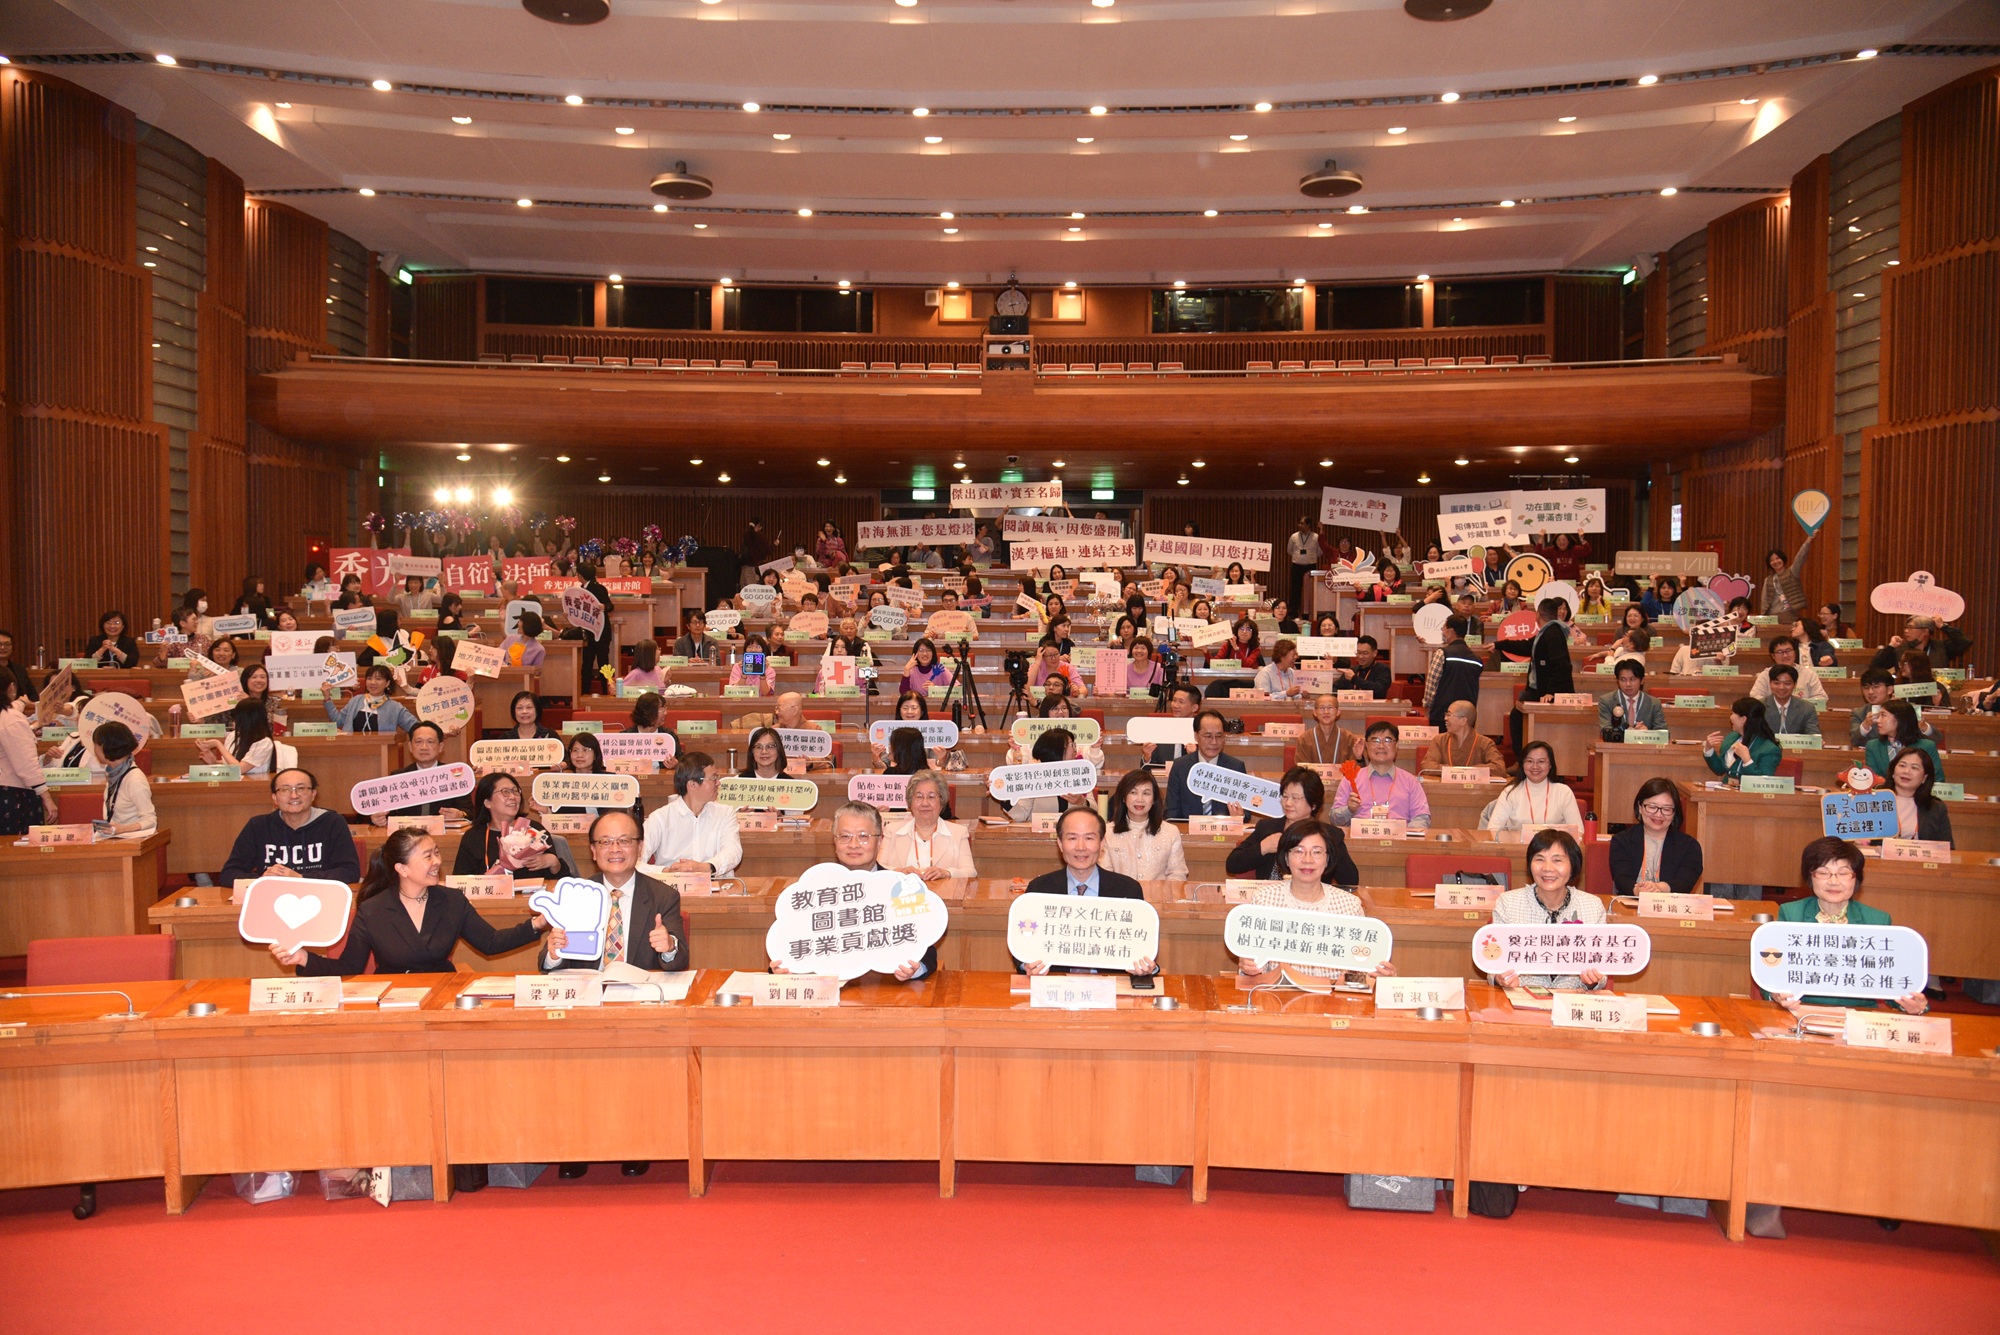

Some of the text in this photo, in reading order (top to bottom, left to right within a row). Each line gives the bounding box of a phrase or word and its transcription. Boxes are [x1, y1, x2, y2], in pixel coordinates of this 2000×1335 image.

[951, 487, 1062, 500] 傑出貢獻，實至名歸
[859, 522, 974, 539] 書海無涯，您是燈塔
[1004, 519, 1120, 538] 閱讀風氣，因您盛開
[1011, 543, 1135, 561] 漢學樞紐，連結全球
[1145, 538, 1271, 562] 卓越國圖，因您打造
[446, 561, 490, 586] 自衍
[543, 581, 641, 592] 香光尼眾院圖書館
[569, 607, 579, 618] FU
[872, 615, 904, 627] GO GO GO
[457, 651, 499, 668] 地方首長獎
[422, 693, 470, 715] 地方首長獎
[1004, 766, 1090, 782] 電影特色與創意閱讀
[358, 772, 449, 799] 讓閱讀成為吸引力的
[542, 780, 630, 791] 專業實證與人文關懷
[719, 783, 813, 795] 樂齡學習與城鄉共榮的
[1006, 777, 1092, 793] 推廣的在地文化據點
[1192, 778, 1249, 803] 智慧化圖書館
[541, 791, 610, 802] 並進的醫學樞紐
[719, 793, 775, 803] 社區生活核心
[264, 842, 323, 865] FJCU
[790, 882, 864, 910] 教育部
[900, 895, 917, 904] YOU
[811, 903, 886, 932] 圖書館
[896, 908, 912, 917] DID
[1044, 904, 1134, 923] 豐厚文化底蘊
[1043, 922, 1148, 942] 打造市民有感的
[1238, 914, 1379, 944] 領航圖書館事業發展
[789, 922, 916, 960] 事業貢獻獎
[1043, 940, 1132, 959] 幸福閱讀城市
[1236, 932, 1345, 958] 樹立卓越新典範
[1507, 934, 1637, 948] 奠定閱讀教育基石
[1787, 933, 1895, 951] 深耕閱讀沃土
[1507, 951, 1636, 964] 厚植全民閱讀素養
[1787, 952, 1895, 969] 點亮臺灣偏鄉
[1787, 970, 1914, 990] 閱讀的黃金推手
[266, 990, 315, 1004] 王涵青
[530, 987, 577, 1001] 梁學政
[1391, 990, 1440, 1004] 曾淑賢
[1571, 1008, 1621, 1023] 陳昭珍
[1865, 1027, 1922, 1044] 許美麗
